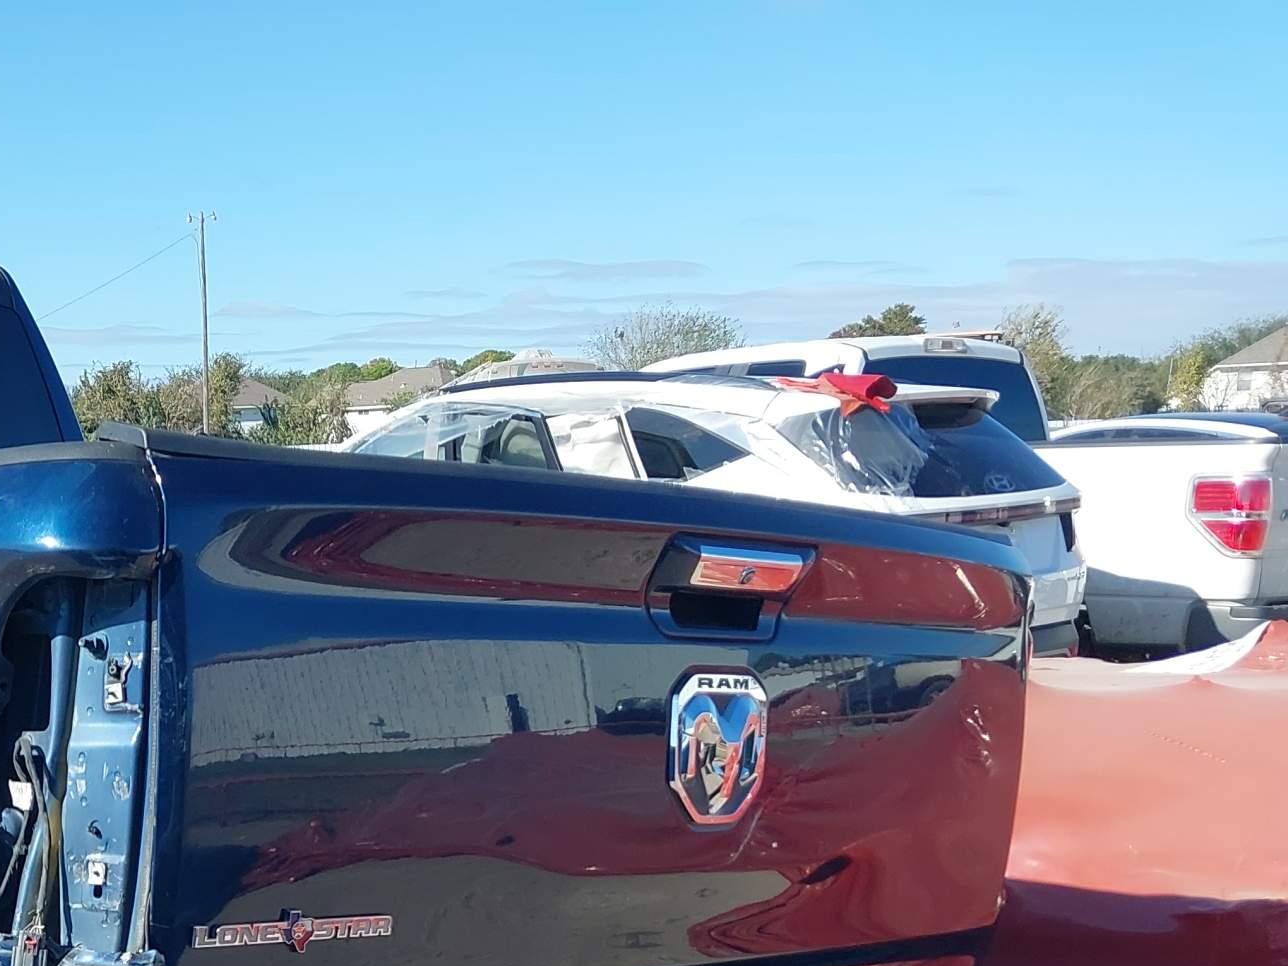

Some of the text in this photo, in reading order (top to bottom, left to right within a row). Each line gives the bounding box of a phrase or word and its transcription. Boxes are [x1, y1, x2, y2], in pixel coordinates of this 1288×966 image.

[697, 677, 750, 691] RAM
[192, 915, 393, 949] LONE STAR
